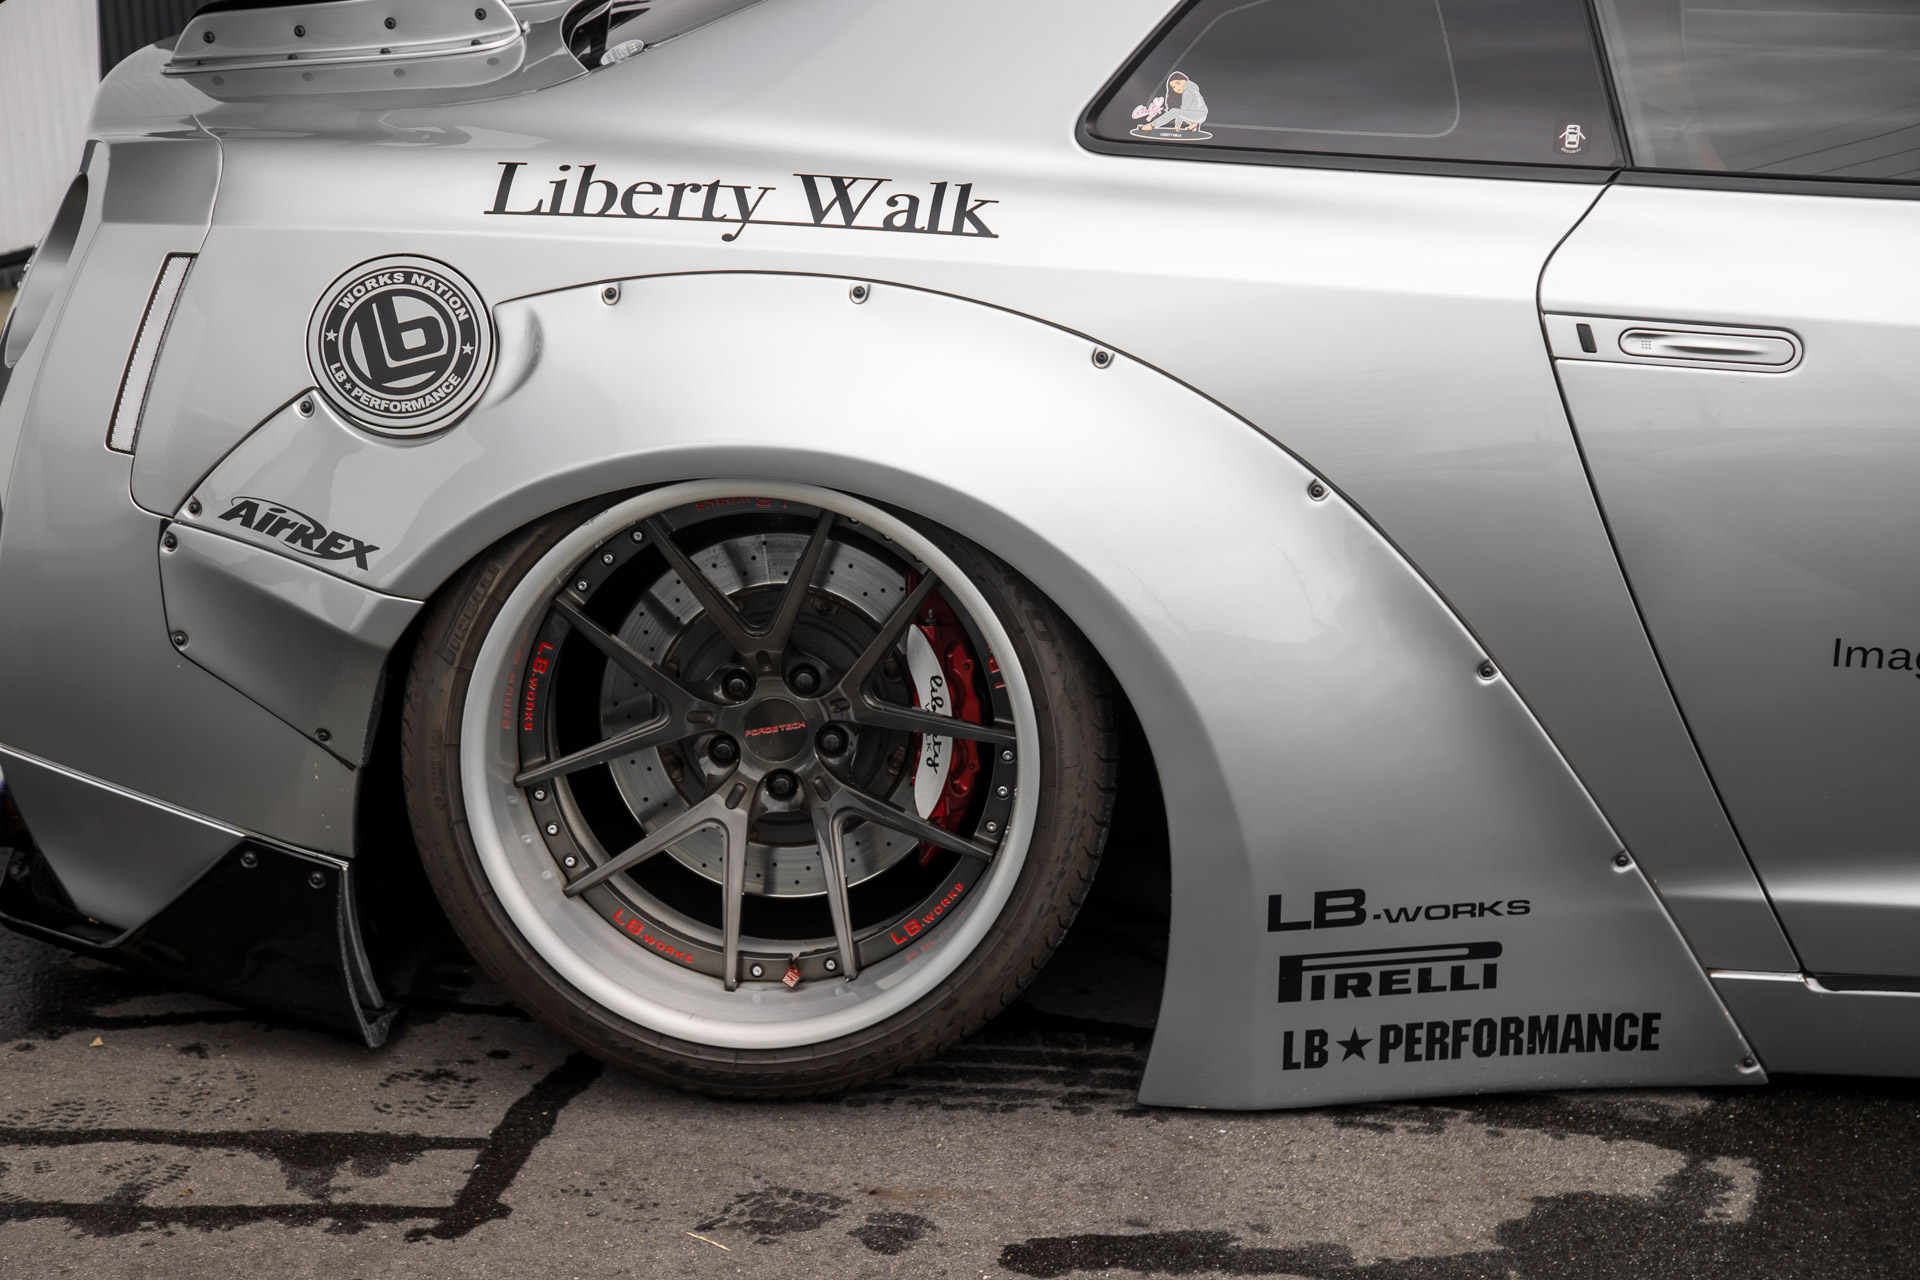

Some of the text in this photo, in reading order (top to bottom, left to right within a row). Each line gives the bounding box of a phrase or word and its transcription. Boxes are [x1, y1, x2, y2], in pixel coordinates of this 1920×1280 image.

[484, 161, 999, 242] Liberty Walk
[338, 272, 470, 322] WORKS NATION
[330, 362, 462, 413] LB PERFORMANCE
[1833, 637, 1920, 680] Ima
[1277, 941, 1503, 1003] PIRELLI
[1378, 1012, 1662, 1065] PERFORMANCE
